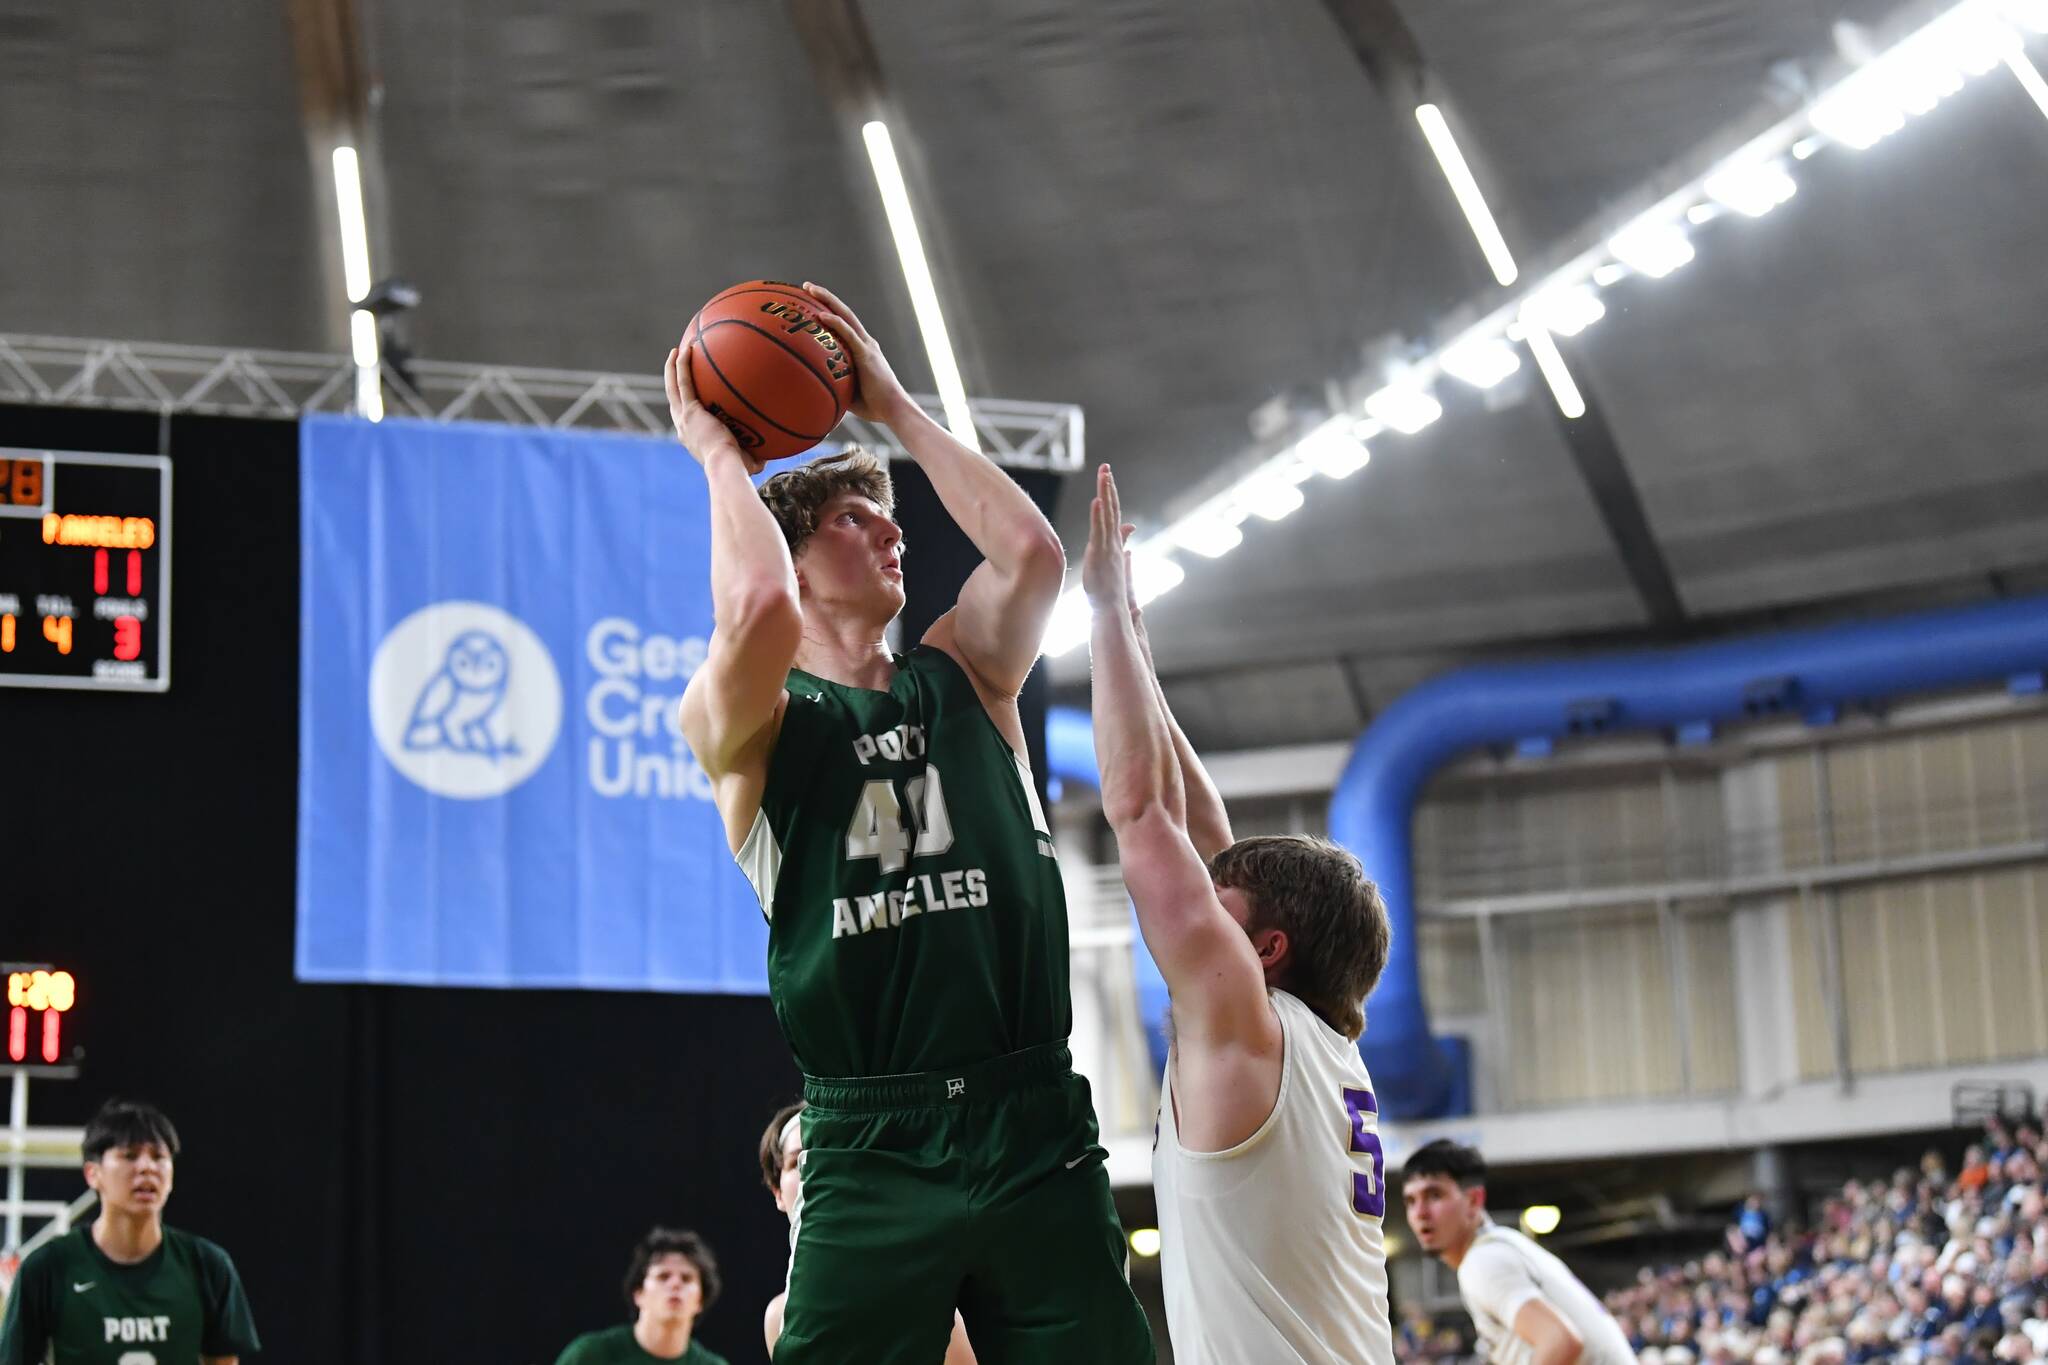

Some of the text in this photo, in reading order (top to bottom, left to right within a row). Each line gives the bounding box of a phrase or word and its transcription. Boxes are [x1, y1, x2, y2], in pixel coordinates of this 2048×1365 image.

[94, 548, 142, 597] 11
[43, 615, 72, 655] 4
[114, 616, 141, 661] 3
[845, 762, 955, 876] 40
[9, 1006, 60, 1063] 11
[1340, 1083, 1386, 1221] 5
[103, 1315, 171, 1343] PORT
